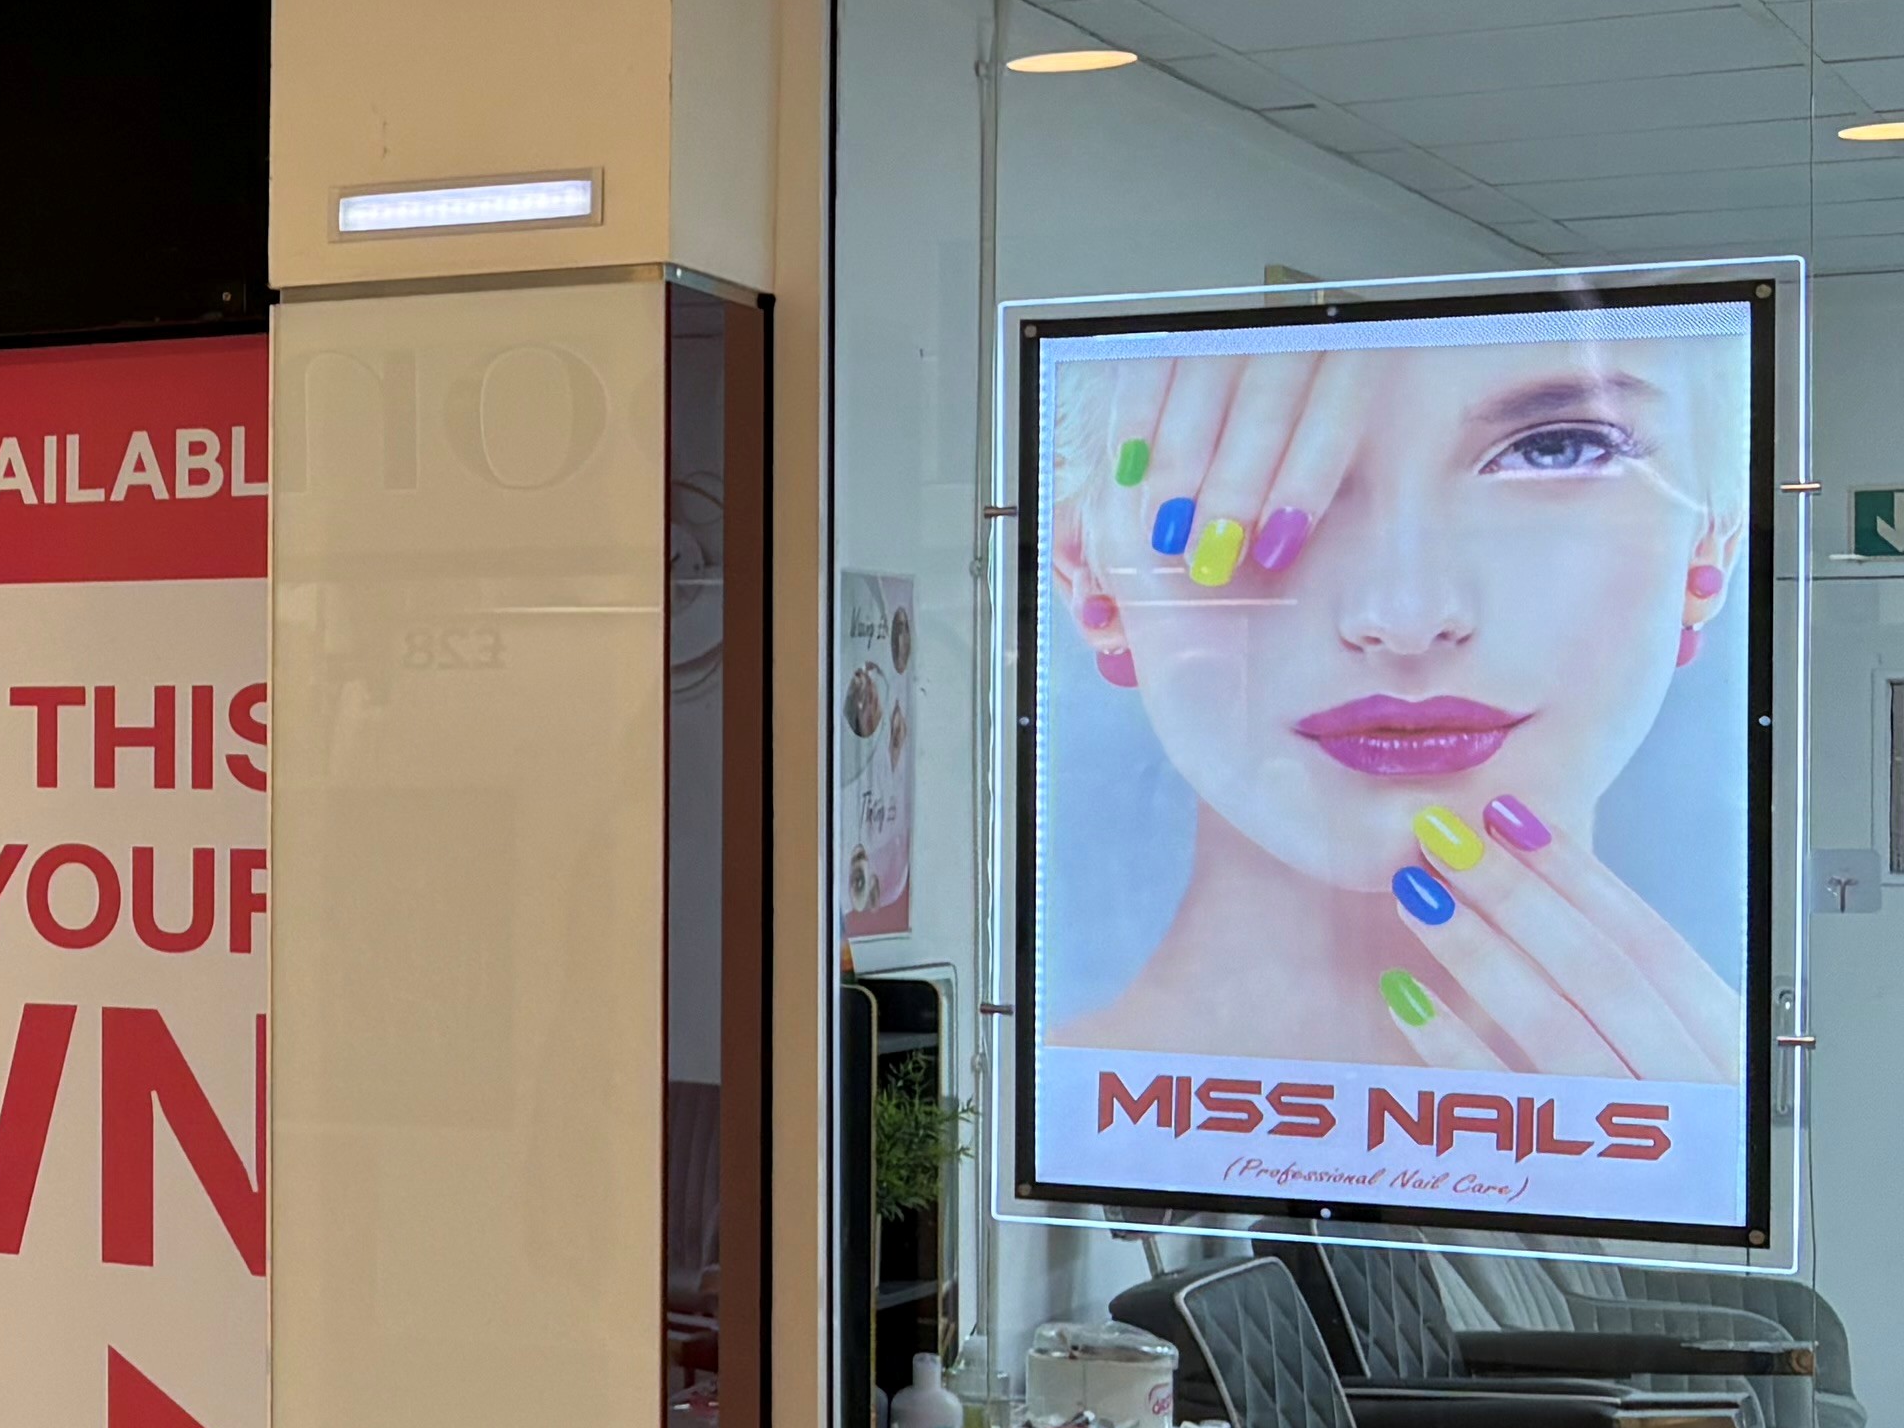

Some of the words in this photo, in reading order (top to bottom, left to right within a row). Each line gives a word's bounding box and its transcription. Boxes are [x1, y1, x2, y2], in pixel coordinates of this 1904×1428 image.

[1097, 1071, 1337, 1139] MISS
[1366, 1087, 1672, 1164] NAILS
[1390, 1169, 1446, 1190] Nail
